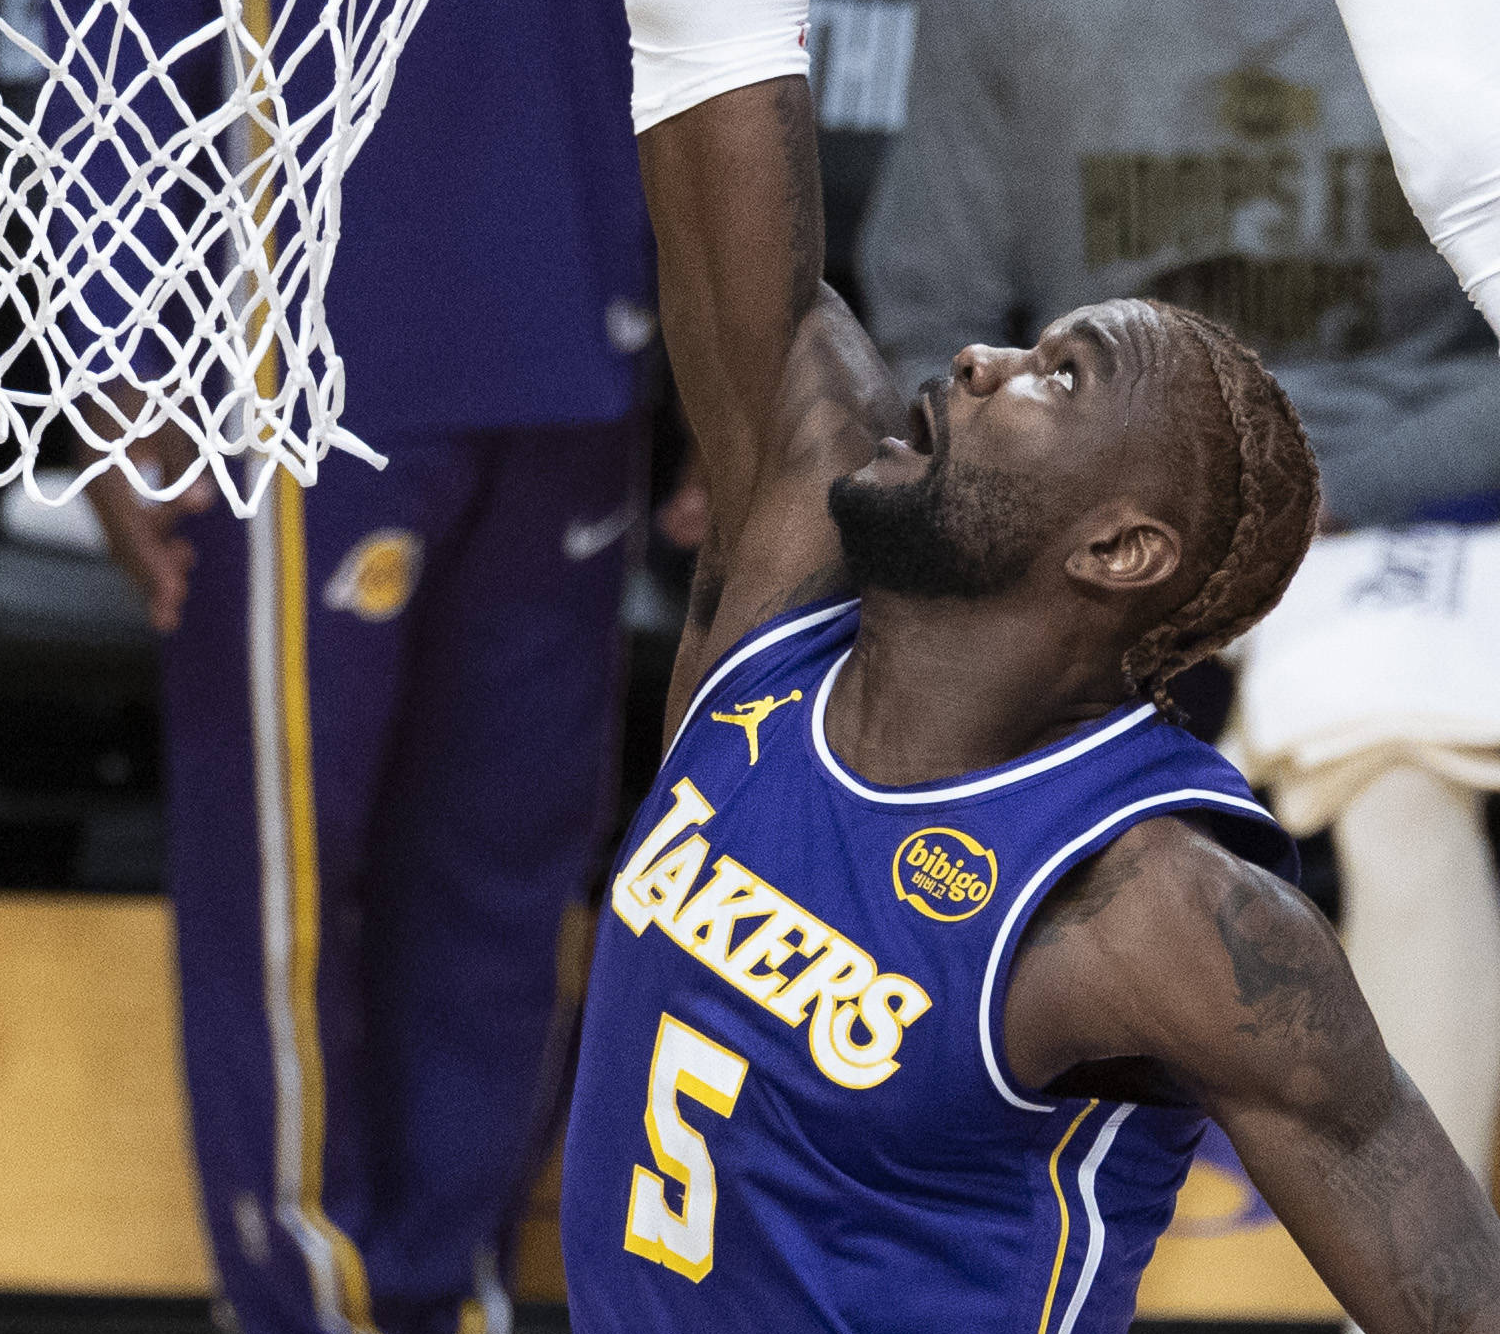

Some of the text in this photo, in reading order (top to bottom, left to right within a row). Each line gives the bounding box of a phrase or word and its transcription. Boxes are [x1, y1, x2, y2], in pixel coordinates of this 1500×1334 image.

[611, 775, 932, 1089] LAKERS
[905, 838, 988, 902] bibigo
[623, 1011, 749, 1283] 5
